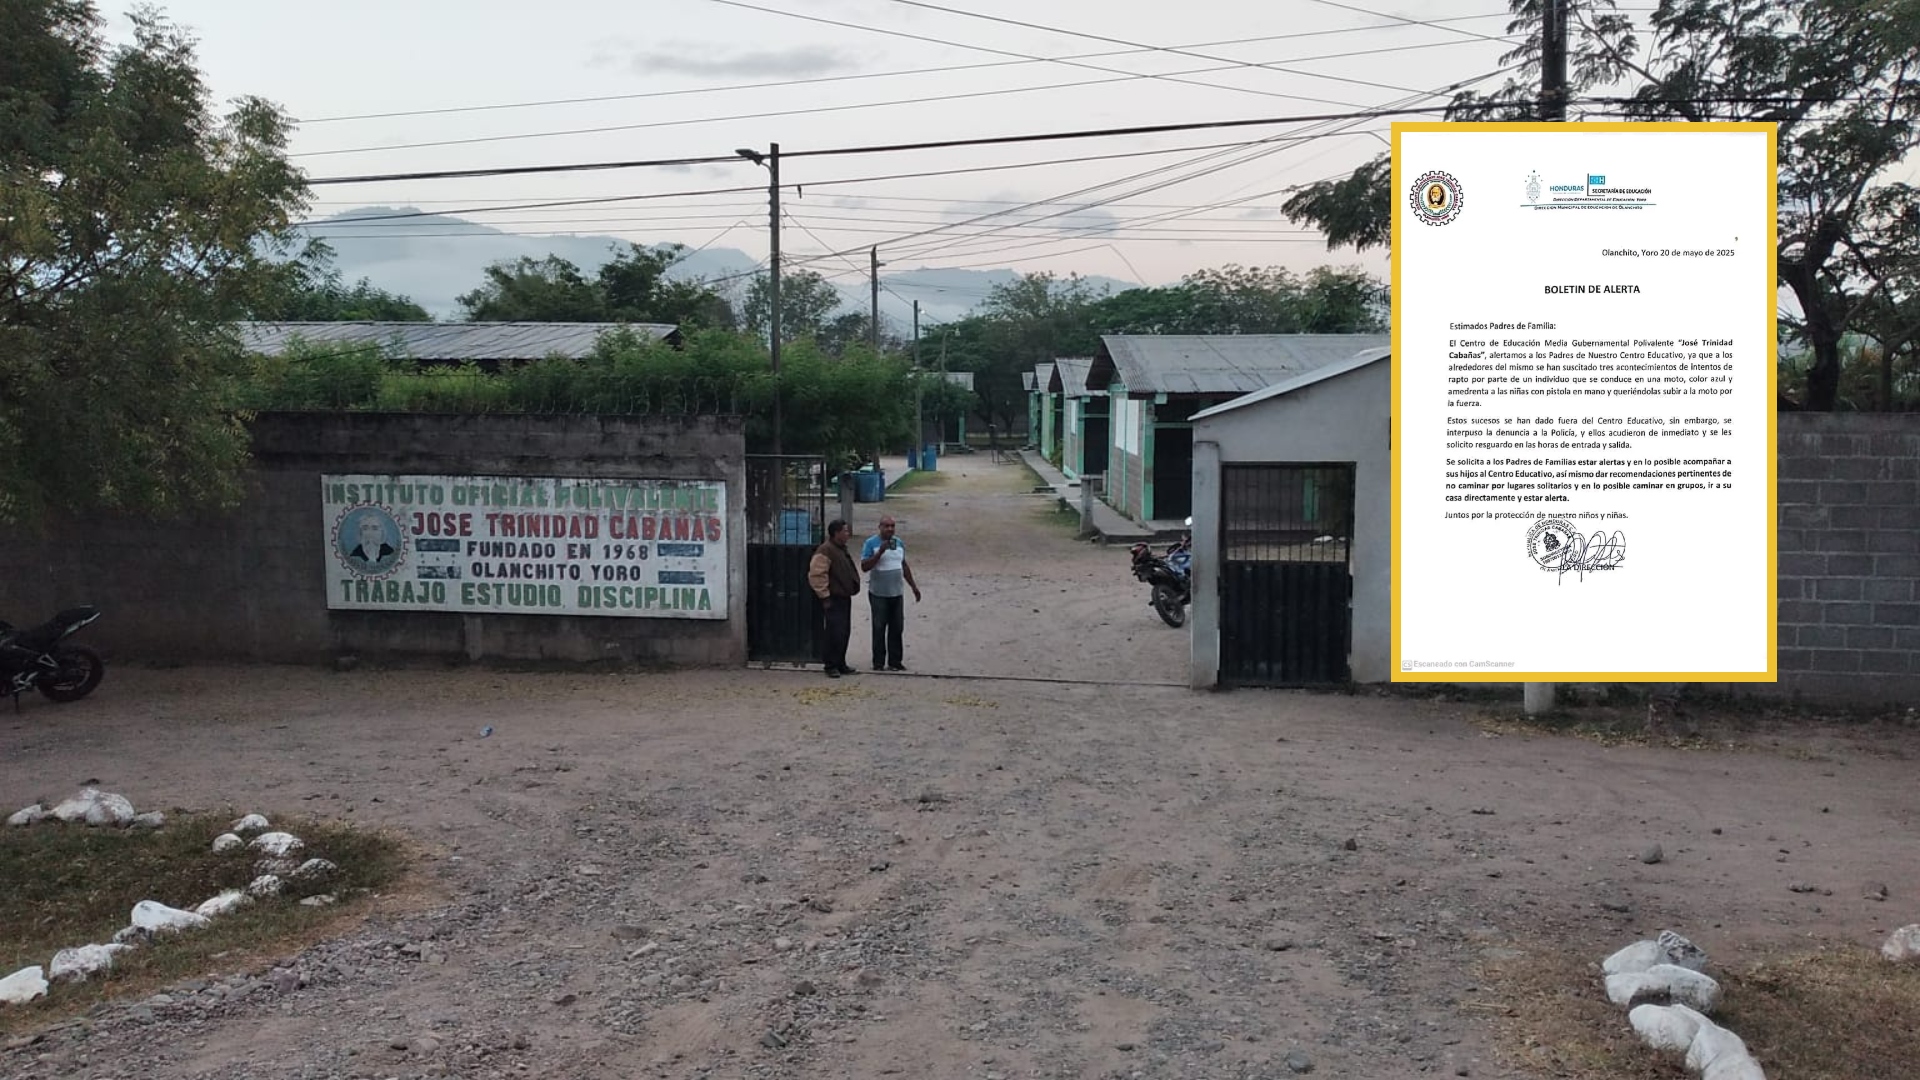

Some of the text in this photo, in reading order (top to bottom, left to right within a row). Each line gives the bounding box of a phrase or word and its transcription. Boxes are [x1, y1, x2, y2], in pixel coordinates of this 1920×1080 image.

[325, 483, 444, 505] INSTITUTO
[452, 484, 549, 508] OFICIAL
[411, 512, 473, 537] JOSE
[486, 513, 599, 540] TRINIDAD
[467, 541, 649, 560] FUNDADO EN 1968
[471, 562, 641, 581] OLANCHITO YORO
[340, 579, 446, 604] TRABAJO
[577, 585, 712, 611] DISCIPLINA
